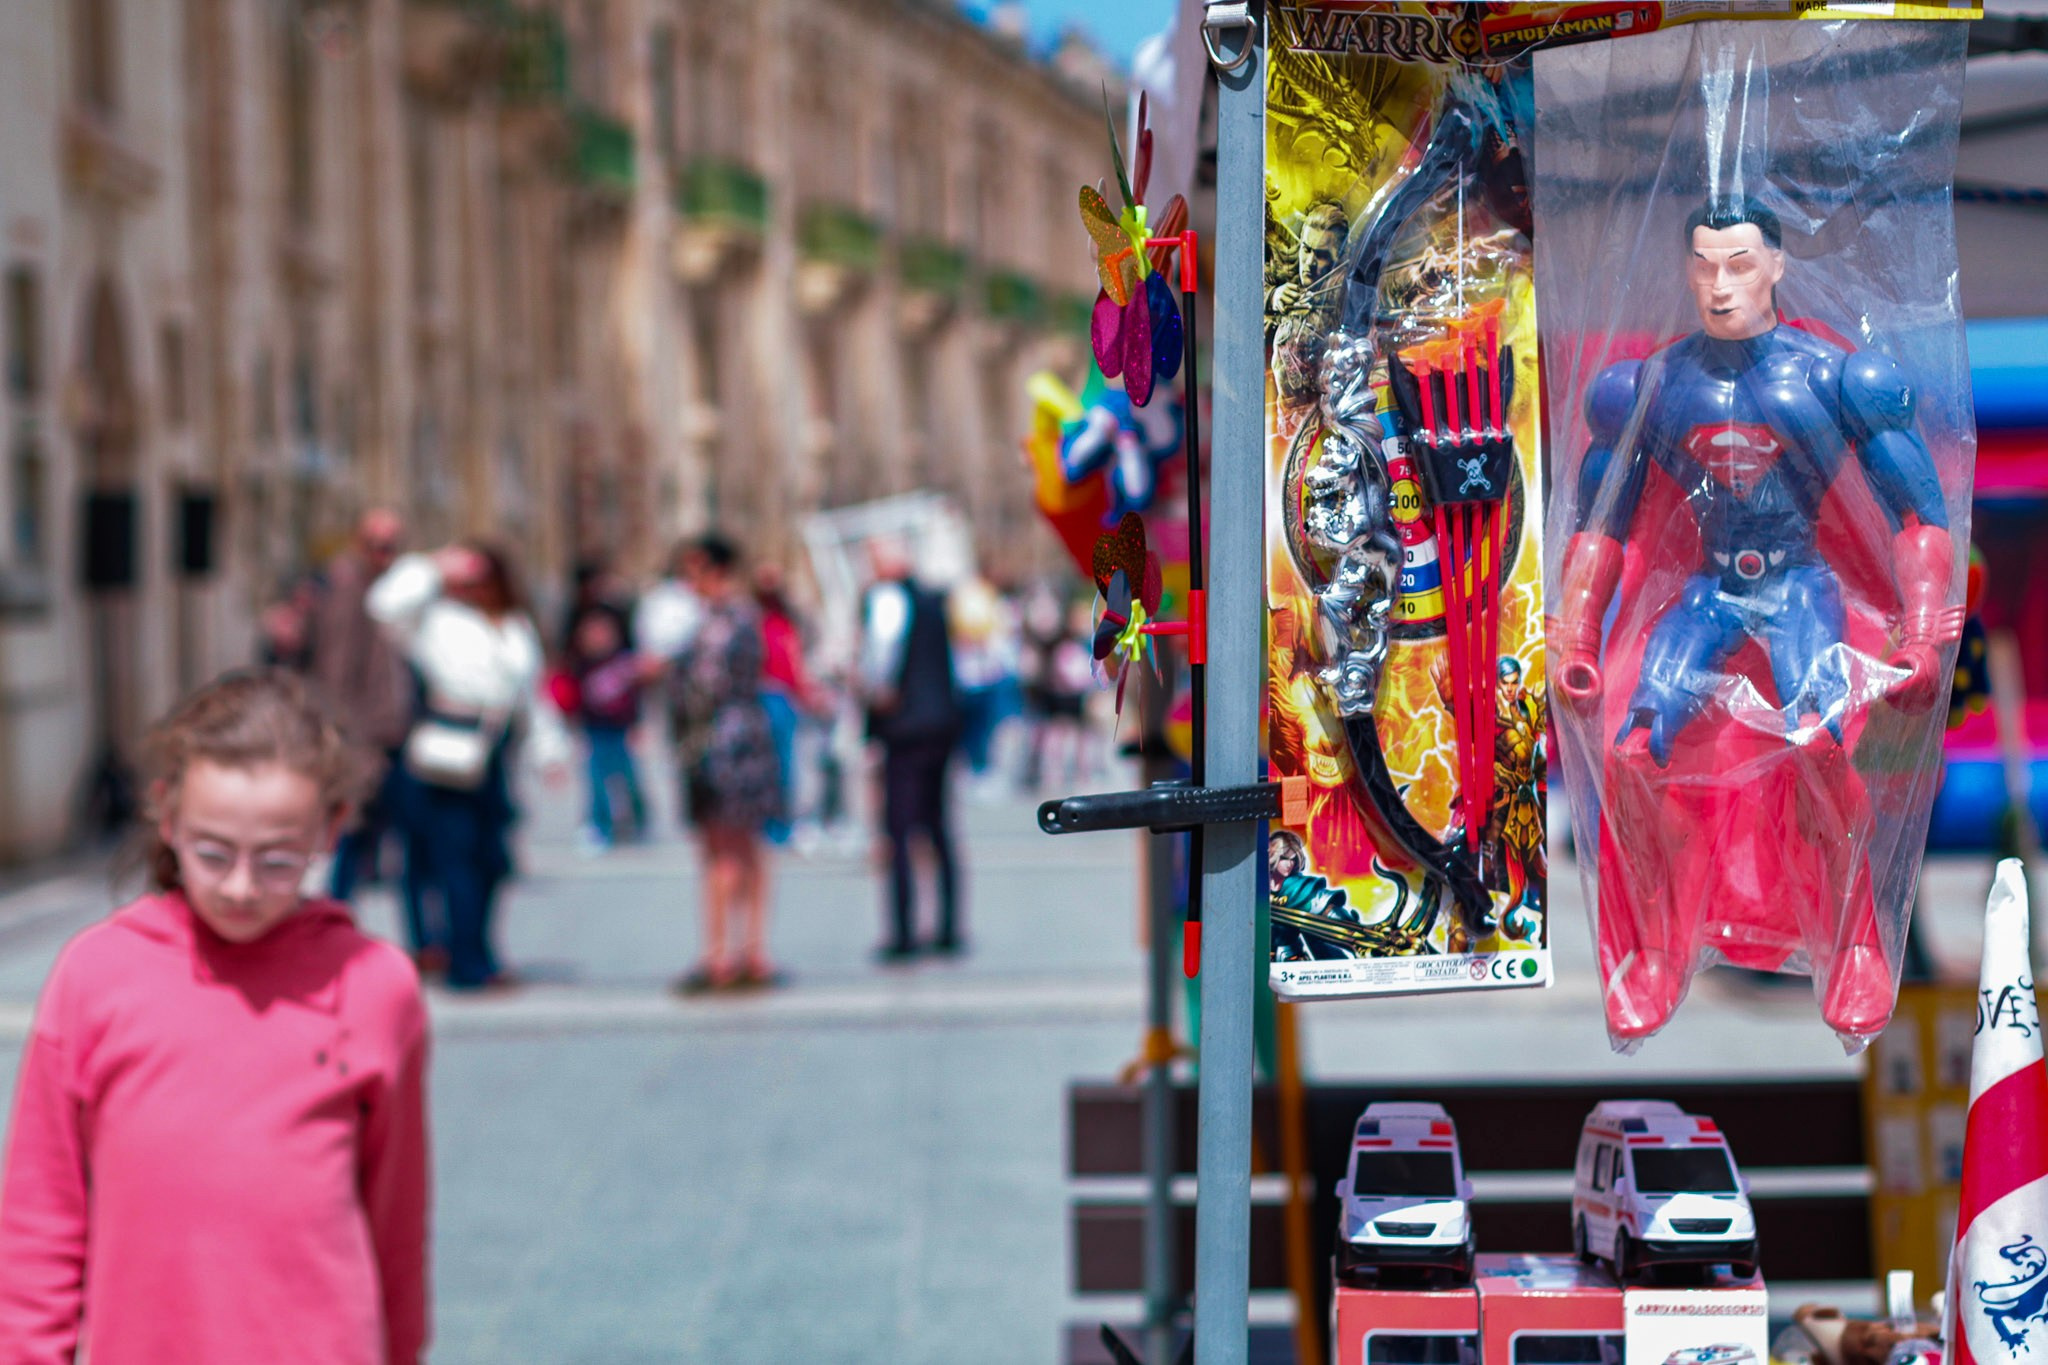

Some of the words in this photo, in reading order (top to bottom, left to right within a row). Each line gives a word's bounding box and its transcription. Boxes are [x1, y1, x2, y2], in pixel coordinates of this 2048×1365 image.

[1795, 1, 1828, 12] MADE
[1401, 574, 1415, 587] 20
[1399, 602, 1415, 614] 10
[1281, 971, 1294, 982] 3+
